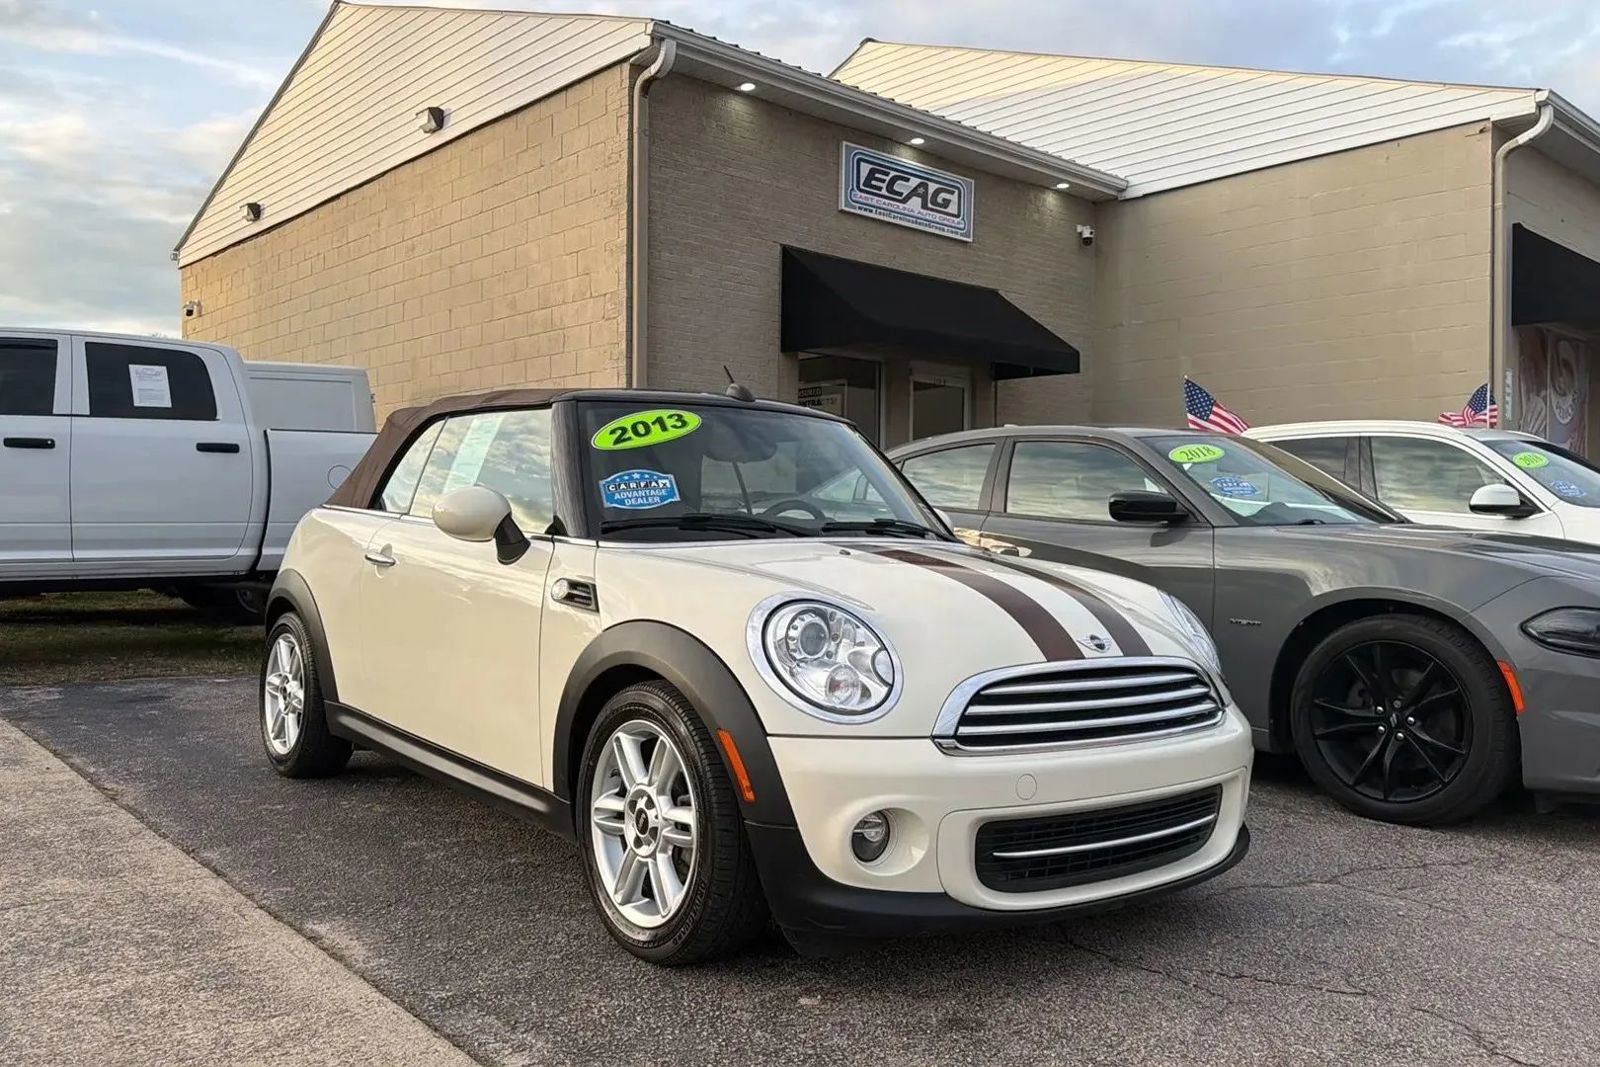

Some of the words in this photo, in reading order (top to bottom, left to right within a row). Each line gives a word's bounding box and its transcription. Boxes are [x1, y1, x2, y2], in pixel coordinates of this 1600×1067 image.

[862, 167, 956, 209] ECAG
[853, 192, 873, 204] EAST
[875, 198, 916, 215] CAROLINA
[916, 209, 937, 220] AUTO
[938, 214, 963, 226] GROUP
[609, 413, 688, 446] 2013
[1180, 446, 1216, 461] 2018
[608, 480, 671, 492] CARFAX
[613, 488, 669, 500] ADVANTAGE
[624, 496, 661, 506] DEALER
